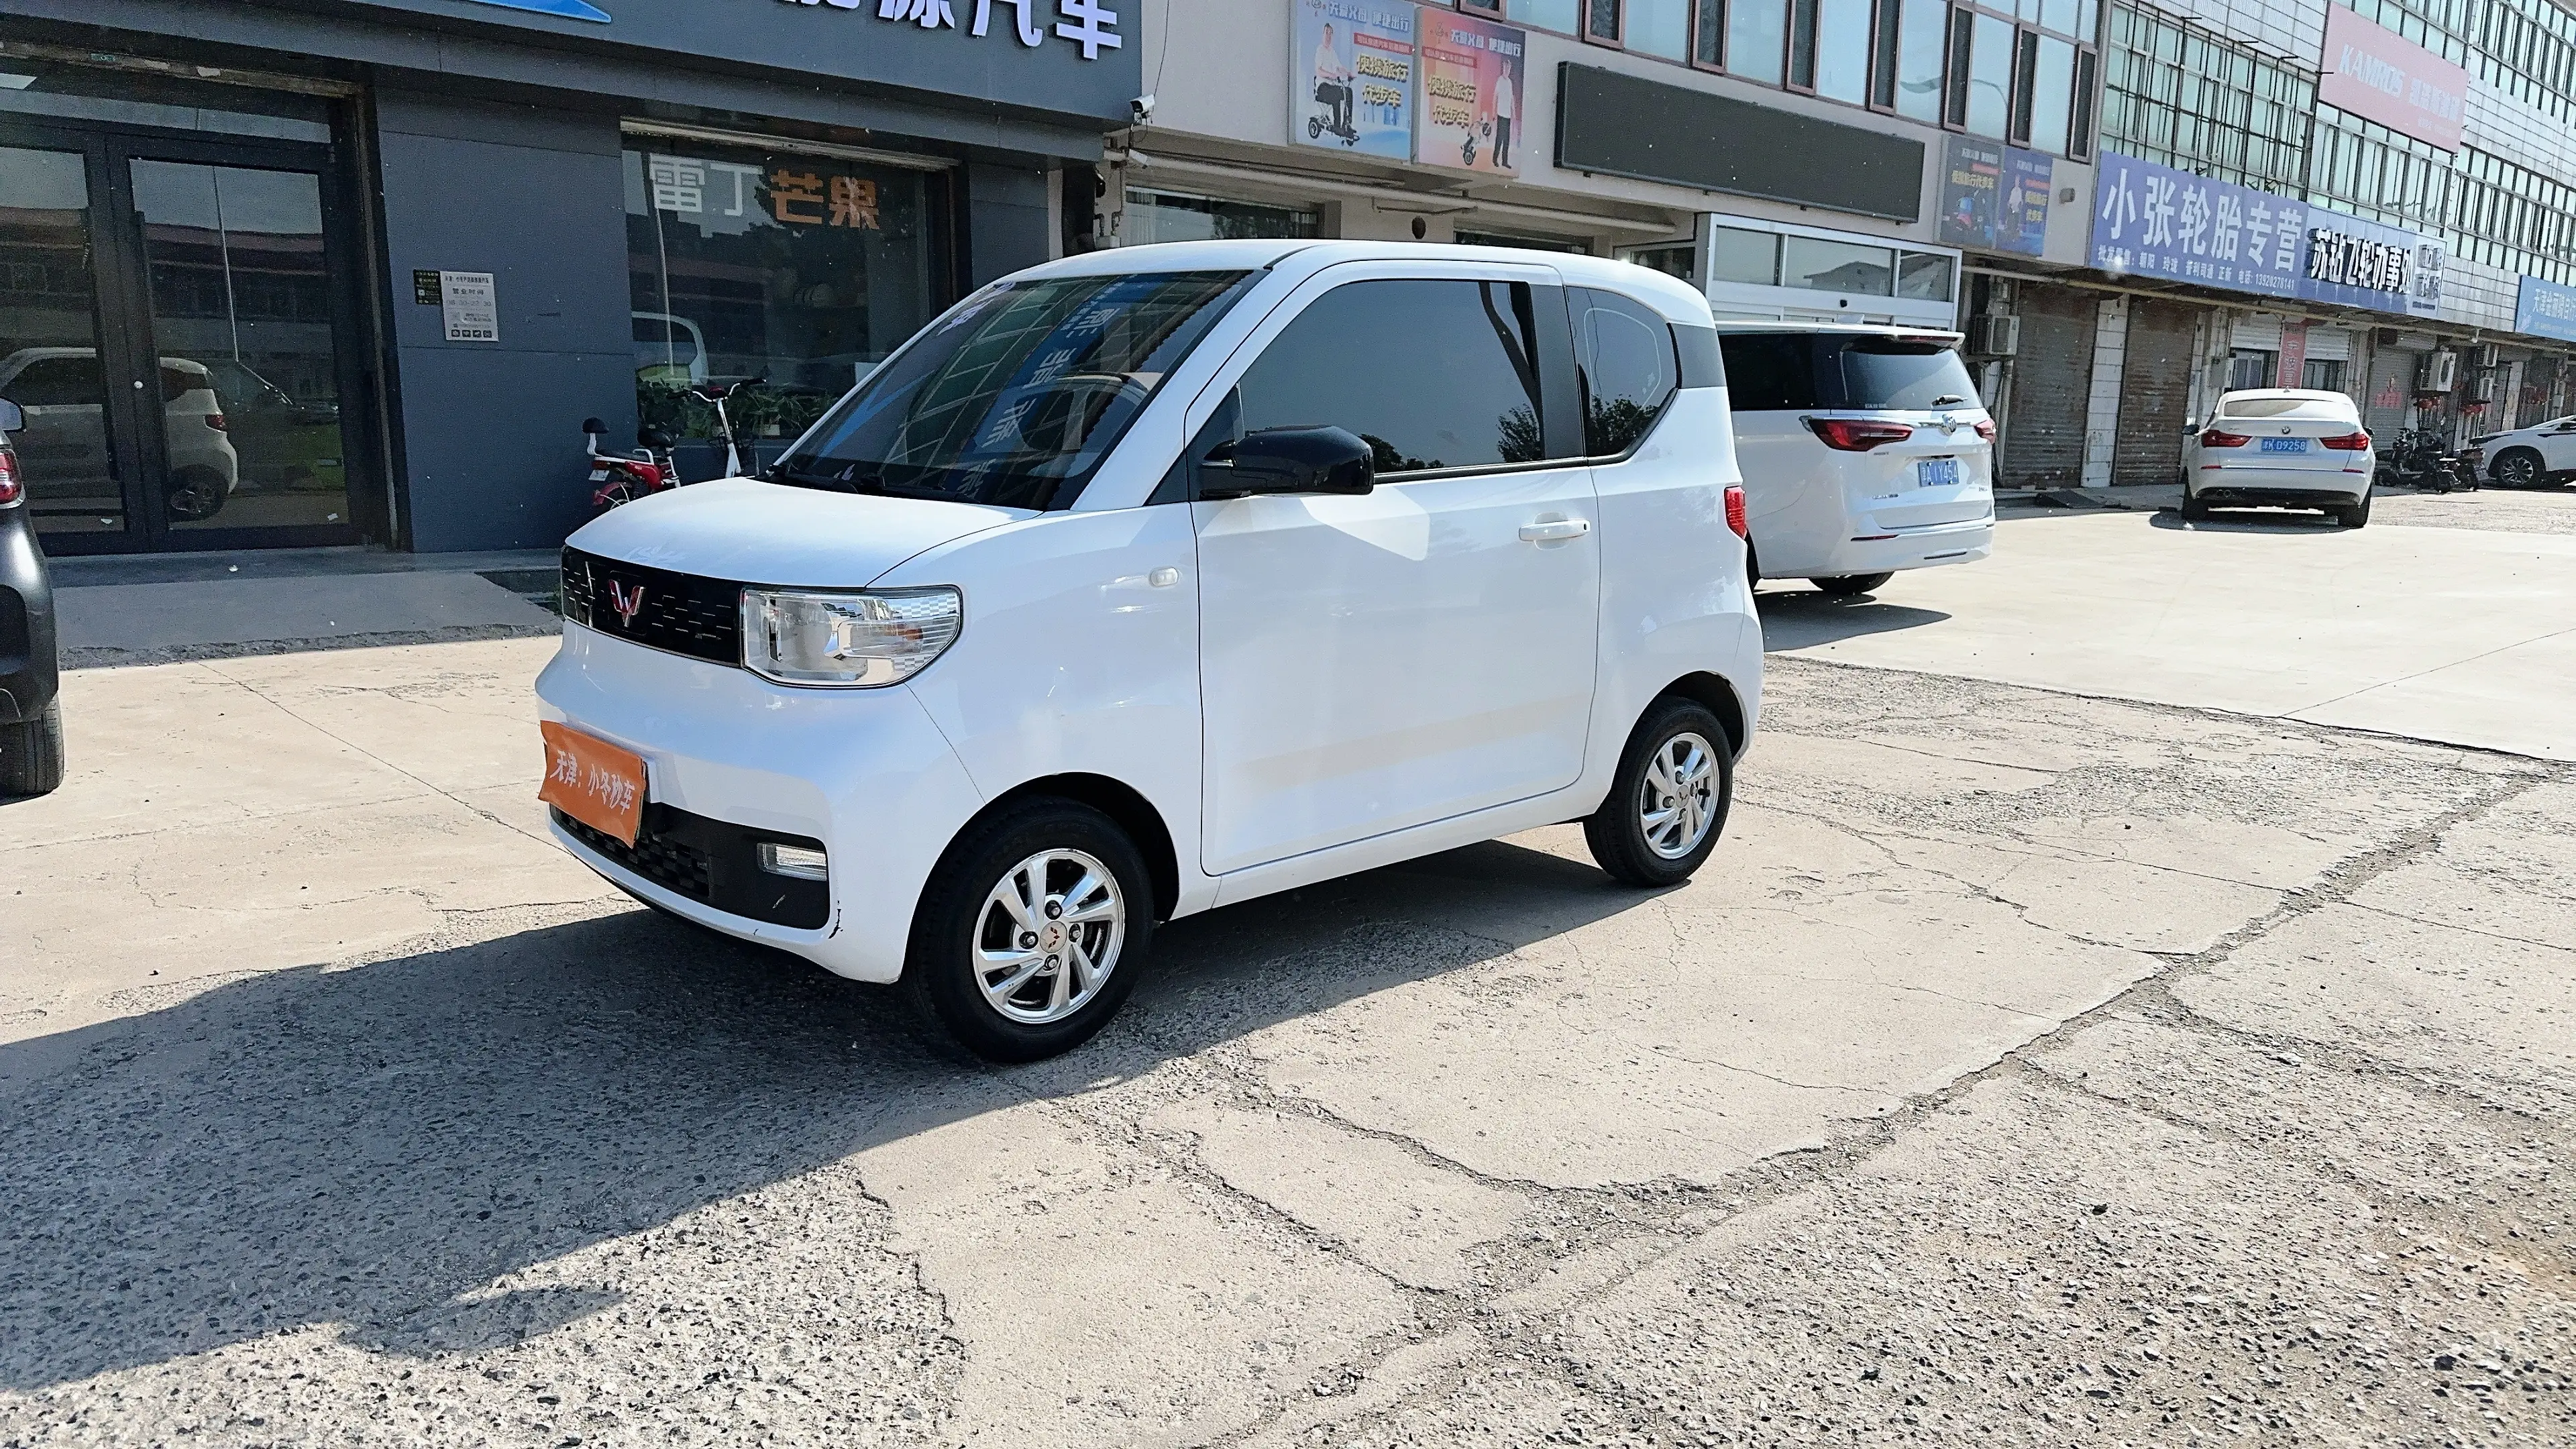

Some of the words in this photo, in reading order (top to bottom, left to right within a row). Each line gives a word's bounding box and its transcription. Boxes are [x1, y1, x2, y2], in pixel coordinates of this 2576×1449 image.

[1362, 82, 1402, 109] 代步车
[2102, 168, 2302, 272] 小张轮胎专营
